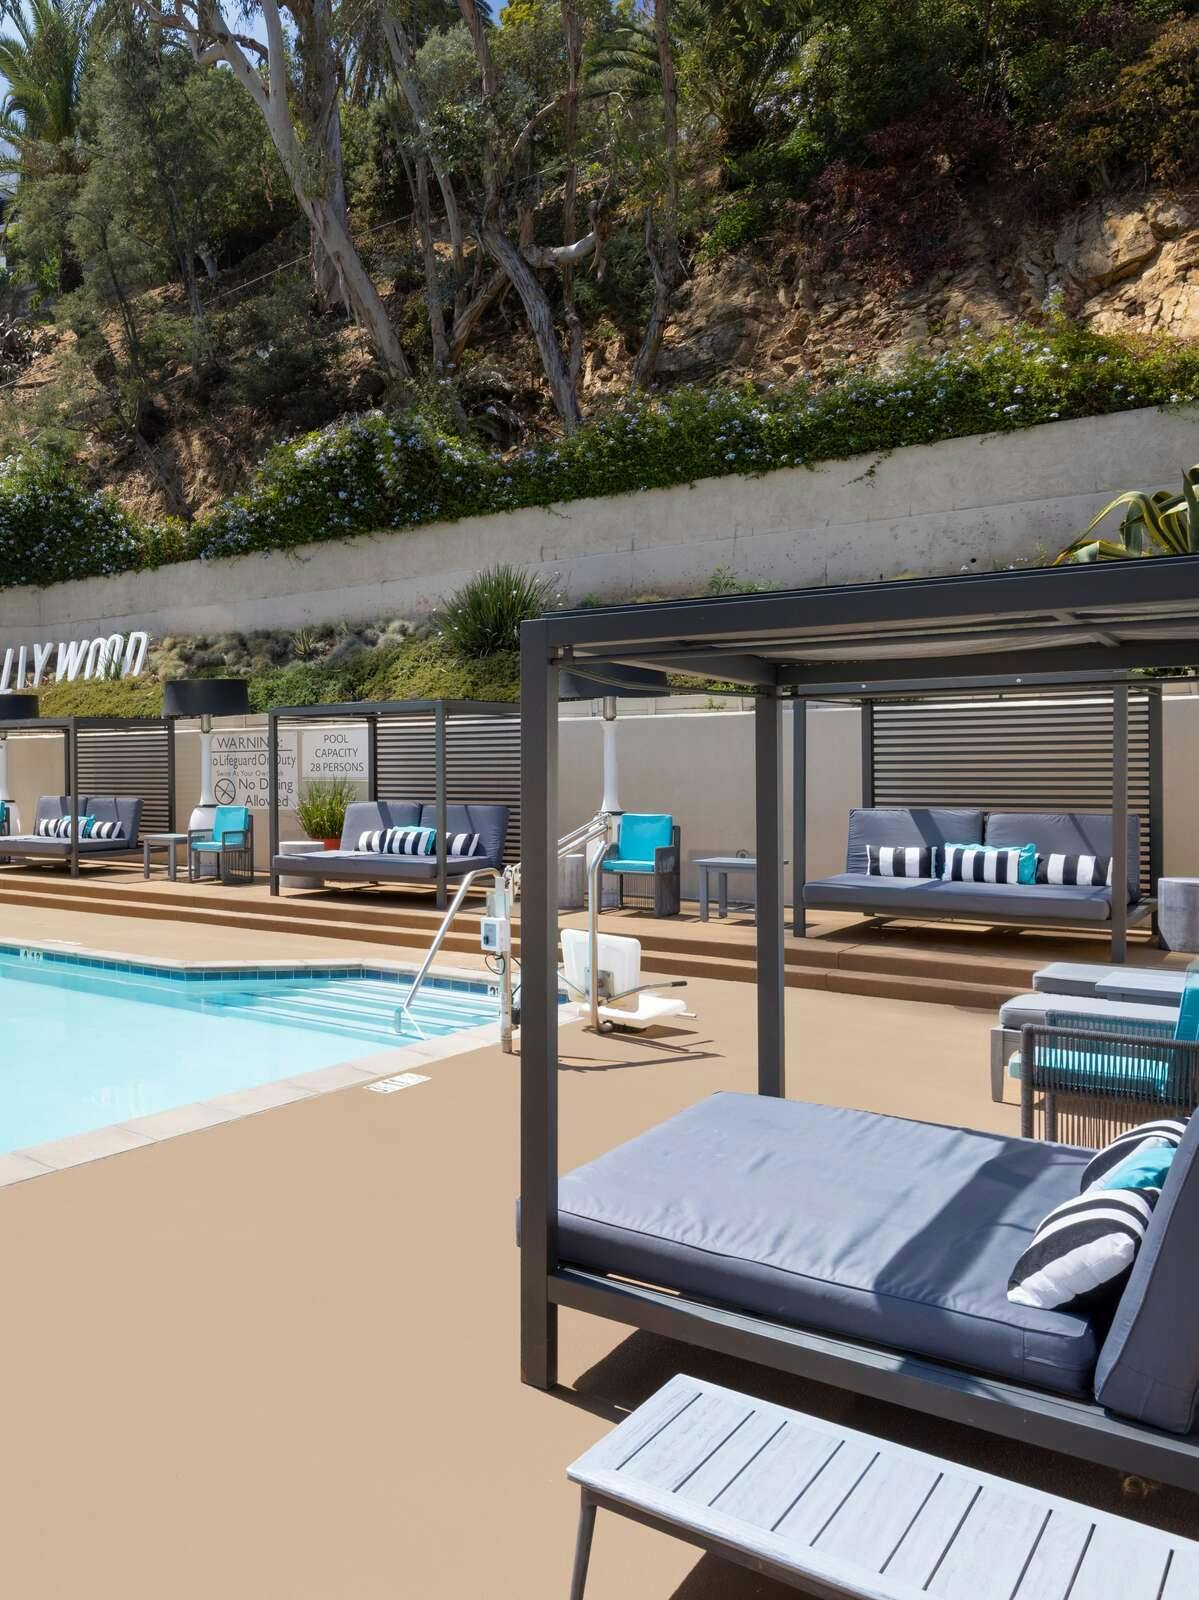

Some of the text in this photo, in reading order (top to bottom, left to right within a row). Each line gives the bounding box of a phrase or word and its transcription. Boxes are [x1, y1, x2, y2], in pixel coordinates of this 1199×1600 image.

[216, 736, 284, 749] WARNIN:
[323, 734, 349, 744] POOL
[314, 747, 359, 758] CAPACITY
[220, 753, 257, 770] Lifeguard
[310, 761, 365, 772] 28 PERSONS
[238, 778, 294, 794] No Ding
